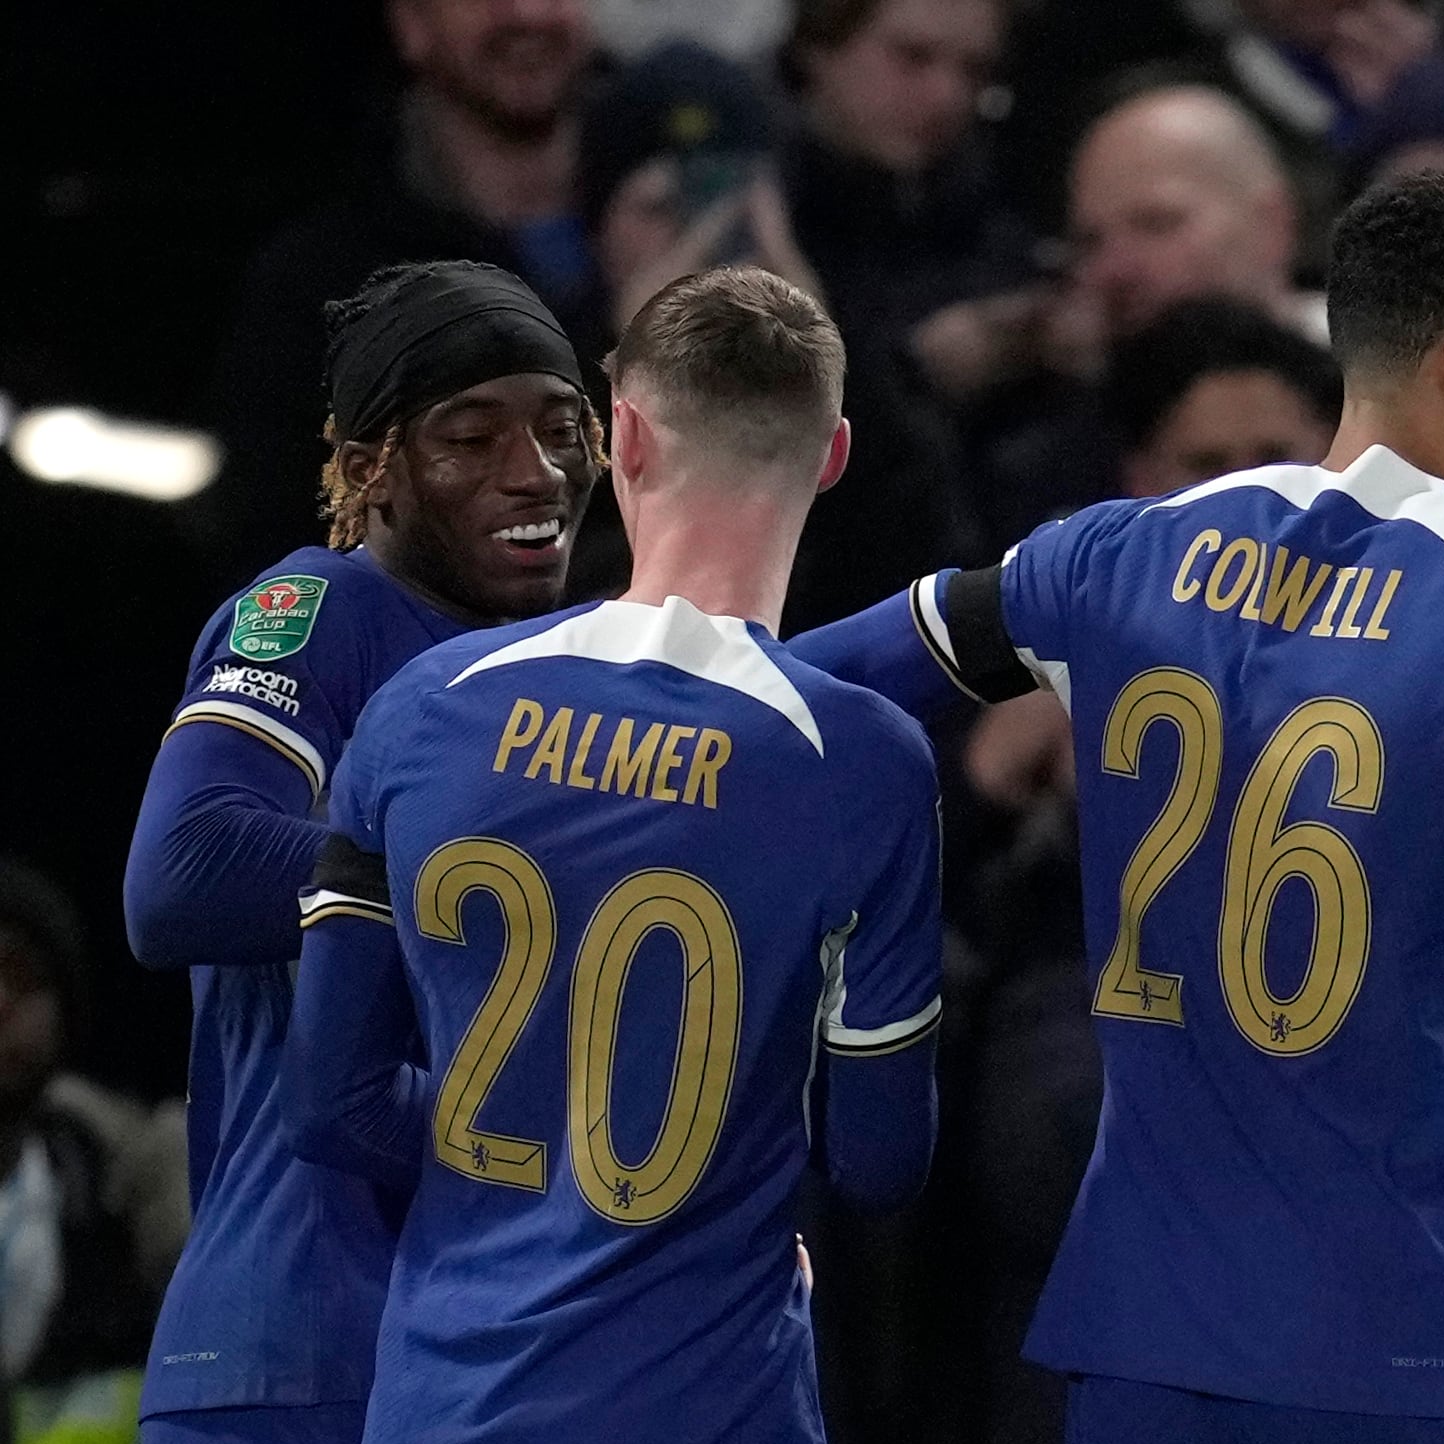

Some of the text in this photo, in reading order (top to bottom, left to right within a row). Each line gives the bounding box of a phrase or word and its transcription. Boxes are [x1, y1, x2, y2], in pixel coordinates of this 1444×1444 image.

[238, 606, 309, 627] Carabao
[1172, 528, 1403, 641] COLWILL
[251, 618, 285, 631] Cup
[261, 640, 282, 651] EFL
[238, 666, 298, 697] room
[492, 698, 733, 809] PALMER
[1091, 665, 1385, 1057] 26
[414, 835, 744, 1227] 20
